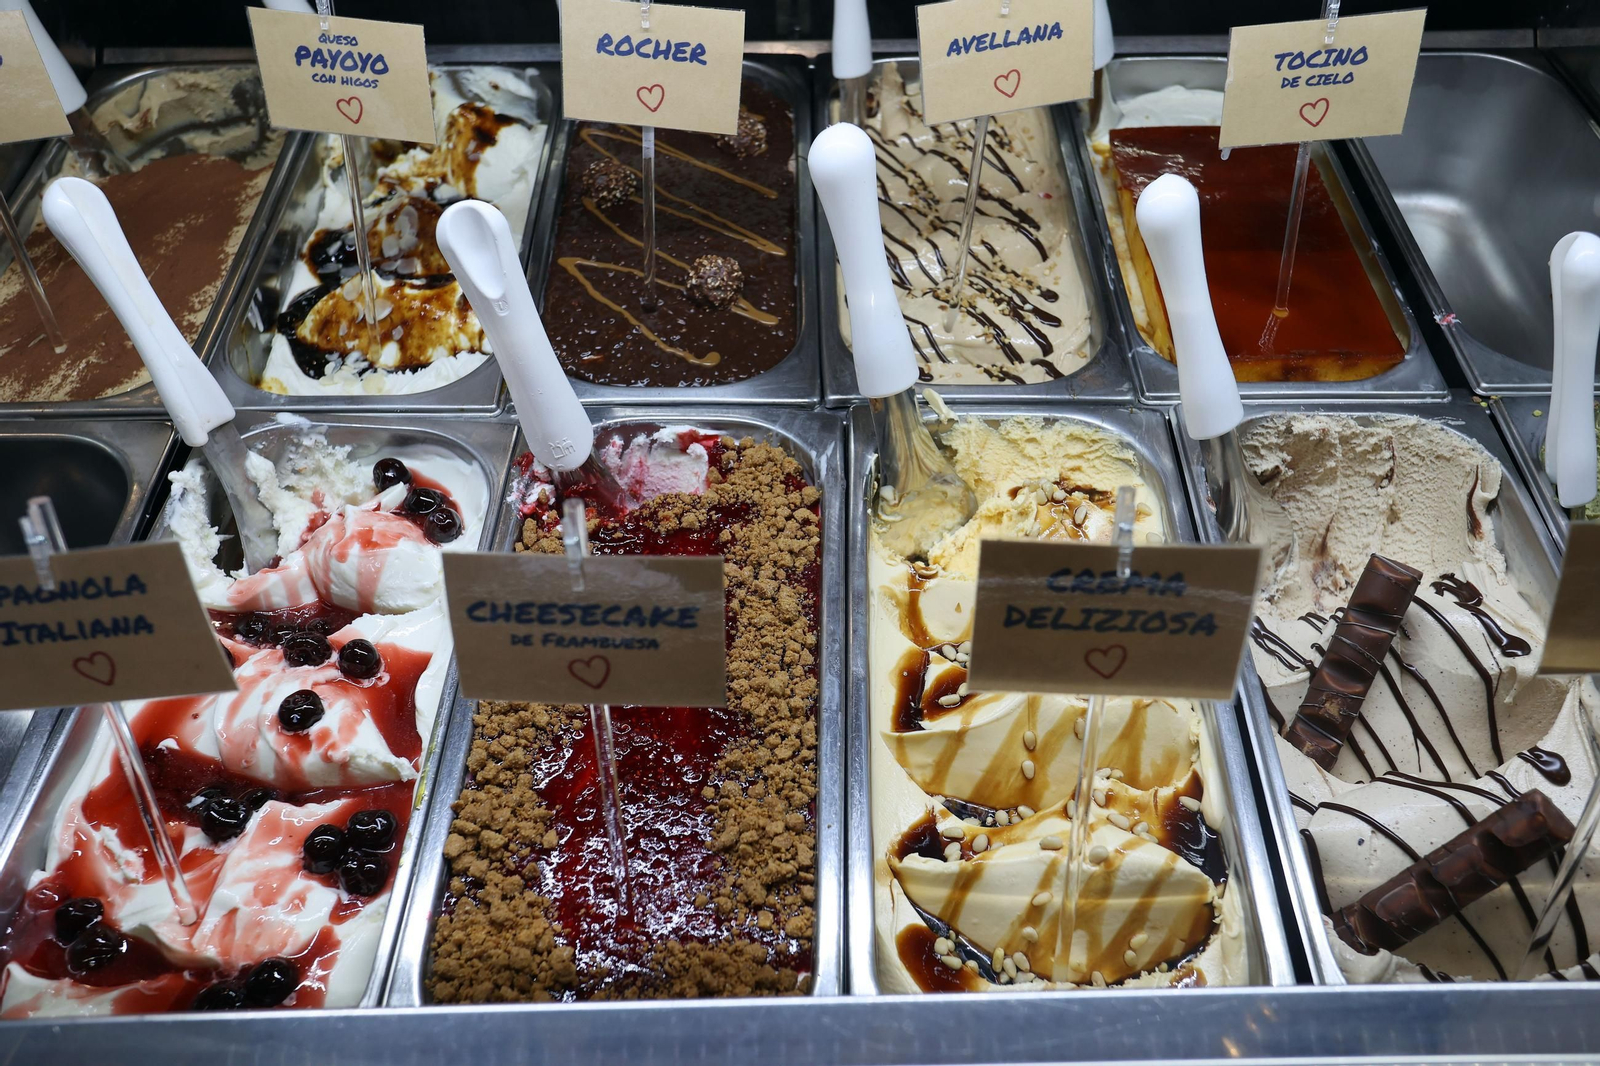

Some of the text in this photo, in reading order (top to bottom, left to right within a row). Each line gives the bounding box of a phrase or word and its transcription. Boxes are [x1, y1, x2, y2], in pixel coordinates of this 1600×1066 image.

[318, 33, 358, 46] QUESO
[596, 33, 707, 66] ROCHER
[946, 21, 1063, 57] AVELLANA
[294, 45, 389, 75] PAYOYO
[1274, 45, 1368, 72] TOCINO
[311, 73, 379, 89] CON HIGOS
[1281, 71, 1354, 89] DE CIELO
[1047, 567, 1187, 597] CREMA
[466, 600, 700, 629] CHEESECAKE
[1003, 604, 1218, 636] DELIZIOSA
[0, 614, 154, 646] ITALIANA
[510, 633, 660, 650] DE FRAMBUESA
